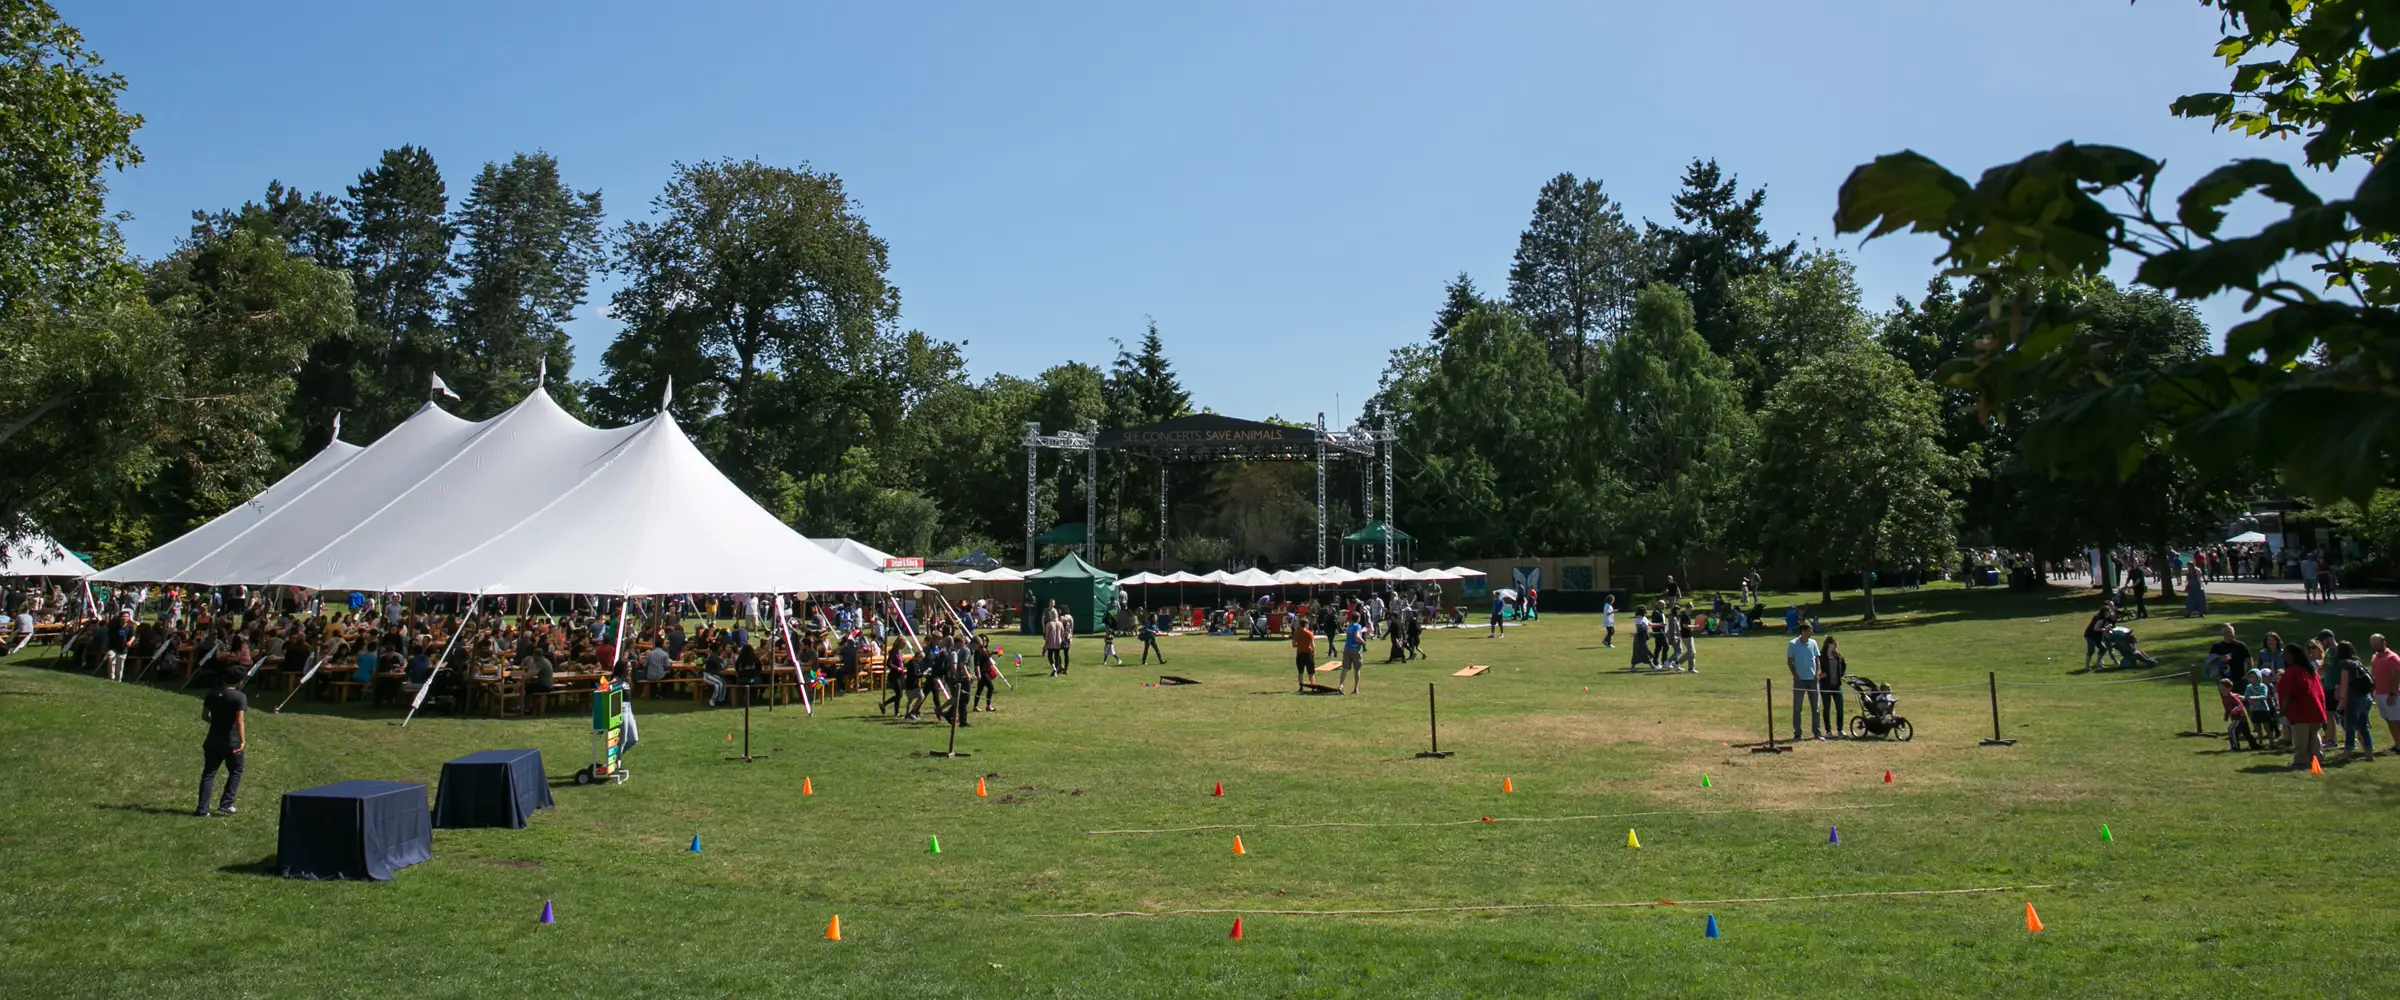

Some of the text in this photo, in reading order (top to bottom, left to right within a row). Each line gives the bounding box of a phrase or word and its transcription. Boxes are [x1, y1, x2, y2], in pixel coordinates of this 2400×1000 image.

[1122, 431, 1140, 441] SEE
[1205, 430, 1231, 441] SAVE
[1232, 429, 1284, 440] ANIMALS.
